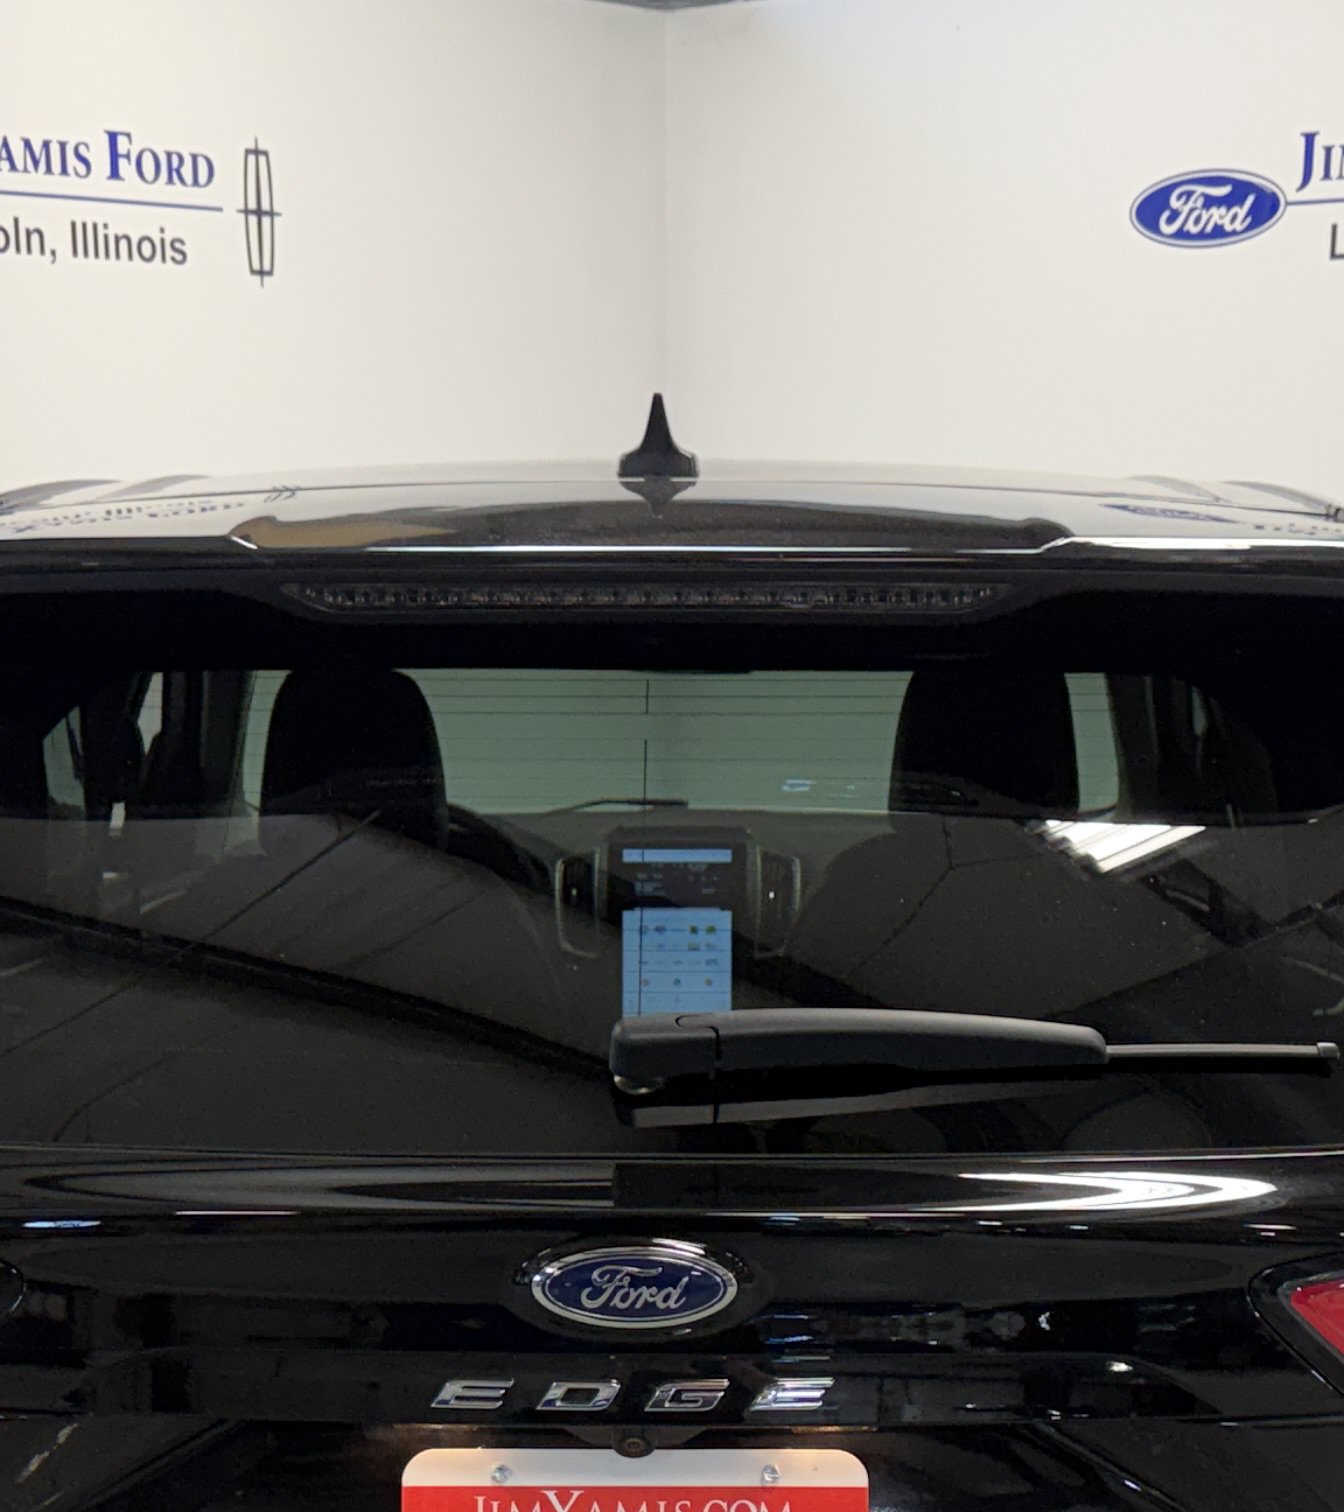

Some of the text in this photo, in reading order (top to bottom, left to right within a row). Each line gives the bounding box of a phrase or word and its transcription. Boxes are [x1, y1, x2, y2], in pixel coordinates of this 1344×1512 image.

[104, 129, 216, 189] FORD
[1159, 182, 1253, 237] Ford
[70, 220, 189, 266] Illinois
[580, 1264, 686, 1311] Ford
[430, 1376, 837, 1412] EDGE
